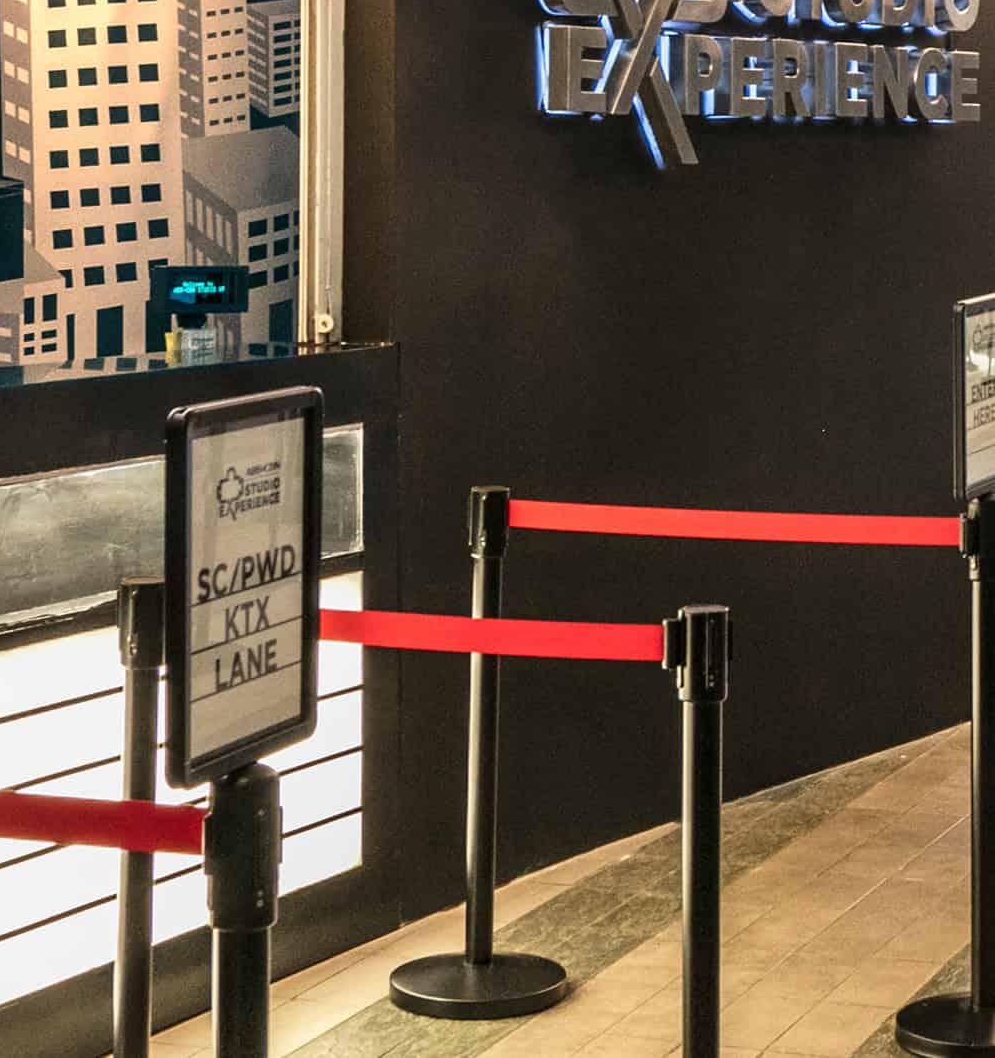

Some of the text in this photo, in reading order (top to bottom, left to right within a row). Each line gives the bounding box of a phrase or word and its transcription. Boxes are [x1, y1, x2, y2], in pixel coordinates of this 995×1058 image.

[219, 491, 280, 521] EXPERIENCE
[245, 477, 280, 496] STUDIO
[197, 545, 296, 602] SC/PWD
[224, 595, 270, 643] KTX
[215, 638, 278, 692] LANE
